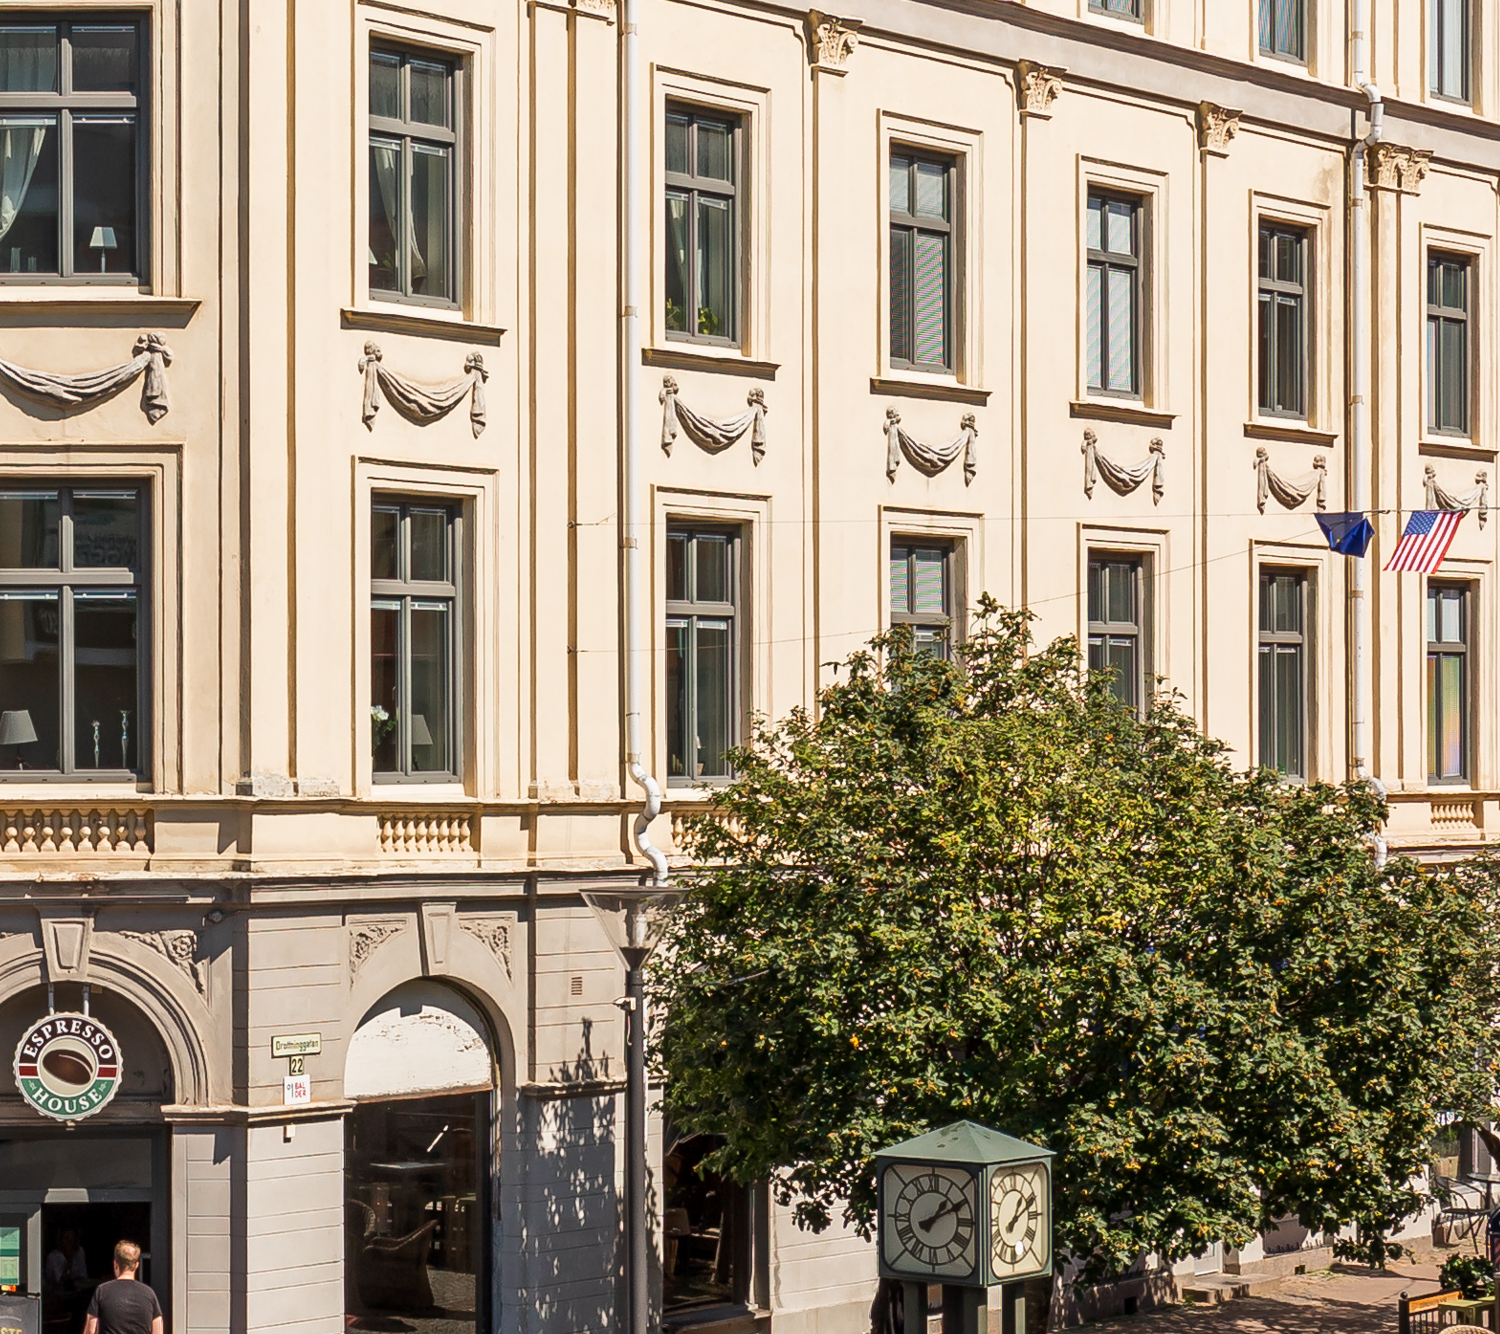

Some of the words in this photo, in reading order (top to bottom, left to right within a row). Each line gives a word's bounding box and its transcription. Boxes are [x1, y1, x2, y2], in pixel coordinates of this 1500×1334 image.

[23, 1019, 113, 1059] ESPRESSO
[291, 1058, 303, 1073] 22
[32, 1087, 103, 1113] HOUSE
